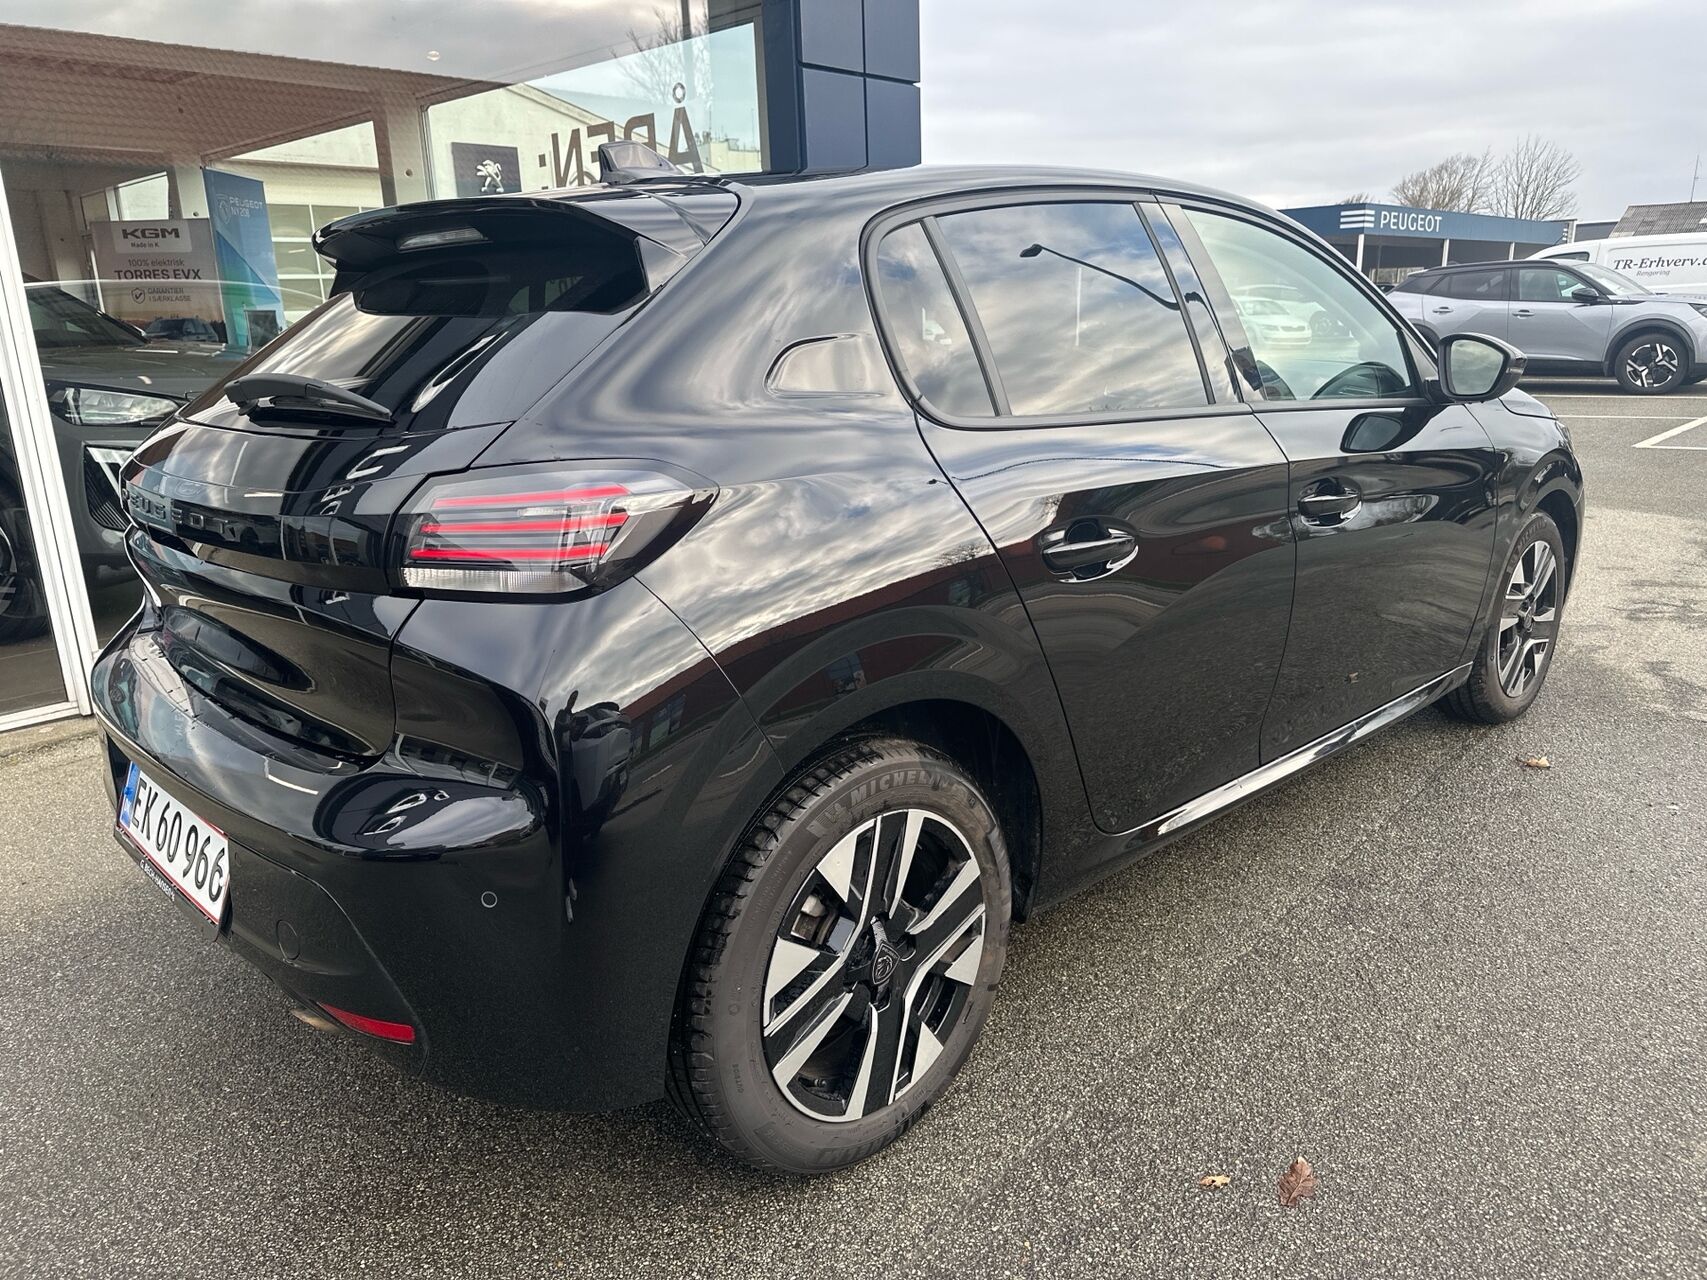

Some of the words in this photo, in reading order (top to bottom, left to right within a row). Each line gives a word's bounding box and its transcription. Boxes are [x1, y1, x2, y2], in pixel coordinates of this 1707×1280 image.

[1380, 211, 1442, 232] PEUGEOT
[122, 228, 180, 239] KGM
[128, 259, 149, 267] 100%
[151, 258, 185, 267] elektrisk
[114, 269, 170, 280] TORRES
[173, 268, 202, 280] EVX
[121, 486, 229, 535] PEUGEOT
[850, 769, 949, 805] MICHELIN
[132, 778, 159, 841] EK
[156, 801, 182, 863] 60
[183, 824, 225, 902] 966
